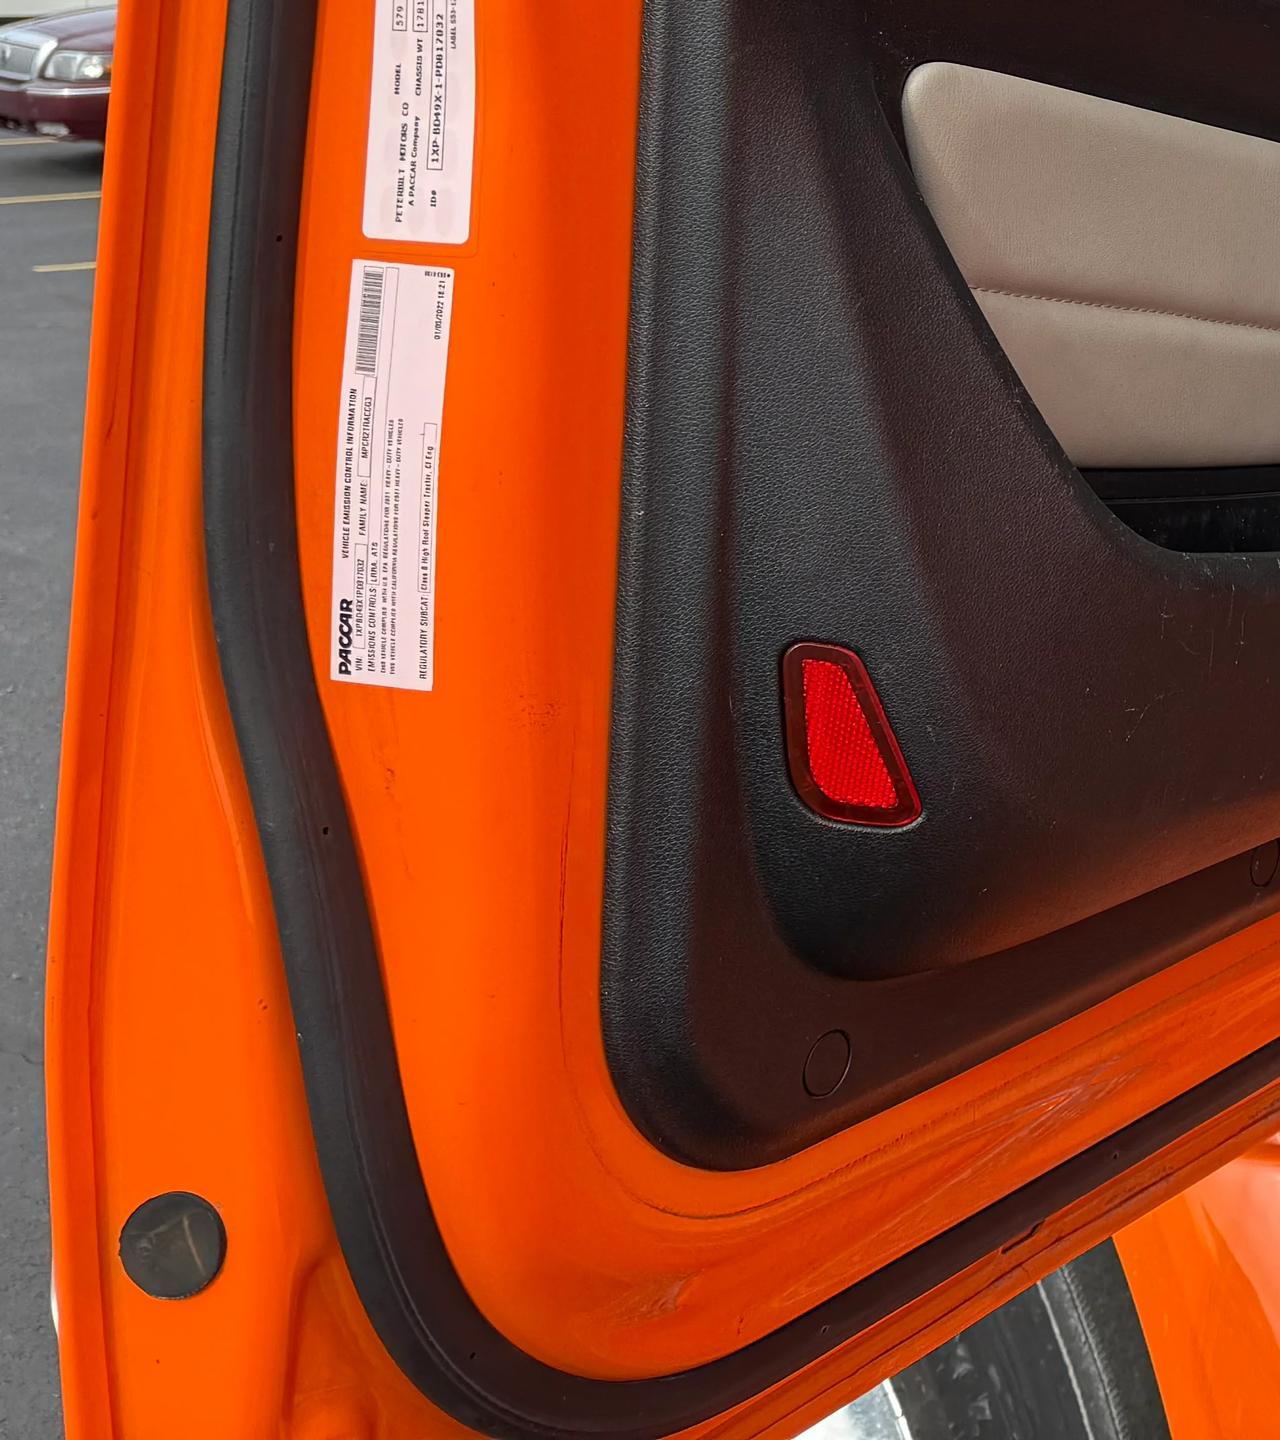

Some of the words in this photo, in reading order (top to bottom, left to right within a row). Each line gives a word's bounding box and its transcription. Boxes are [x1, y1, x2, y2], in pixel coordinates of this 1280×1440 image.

[396, 6, 404, 26] 579
[417, 38, 423, 52] WT
[415, 56, 423, 96] CHASSIS
[402, 102, 409, 116] CO
[399, 123, 407, 161] MOTORS
[411, 116, 420, 157] Company
[395, 169, 405, 223] PETERBILT
[347, 388, 357, 444] INFORMATION
[345, 448, 353, 483] CONTROL
[425, 446, 433, 459] Eng
[343, 486, 351, 525] EMISSION
[342, 528, 350, 558] VEHICLE
[421, 548, 429, 563] High
[338, 599, 352, 675] PACCAR
[419, 630, 427, 679] REGULATORY
